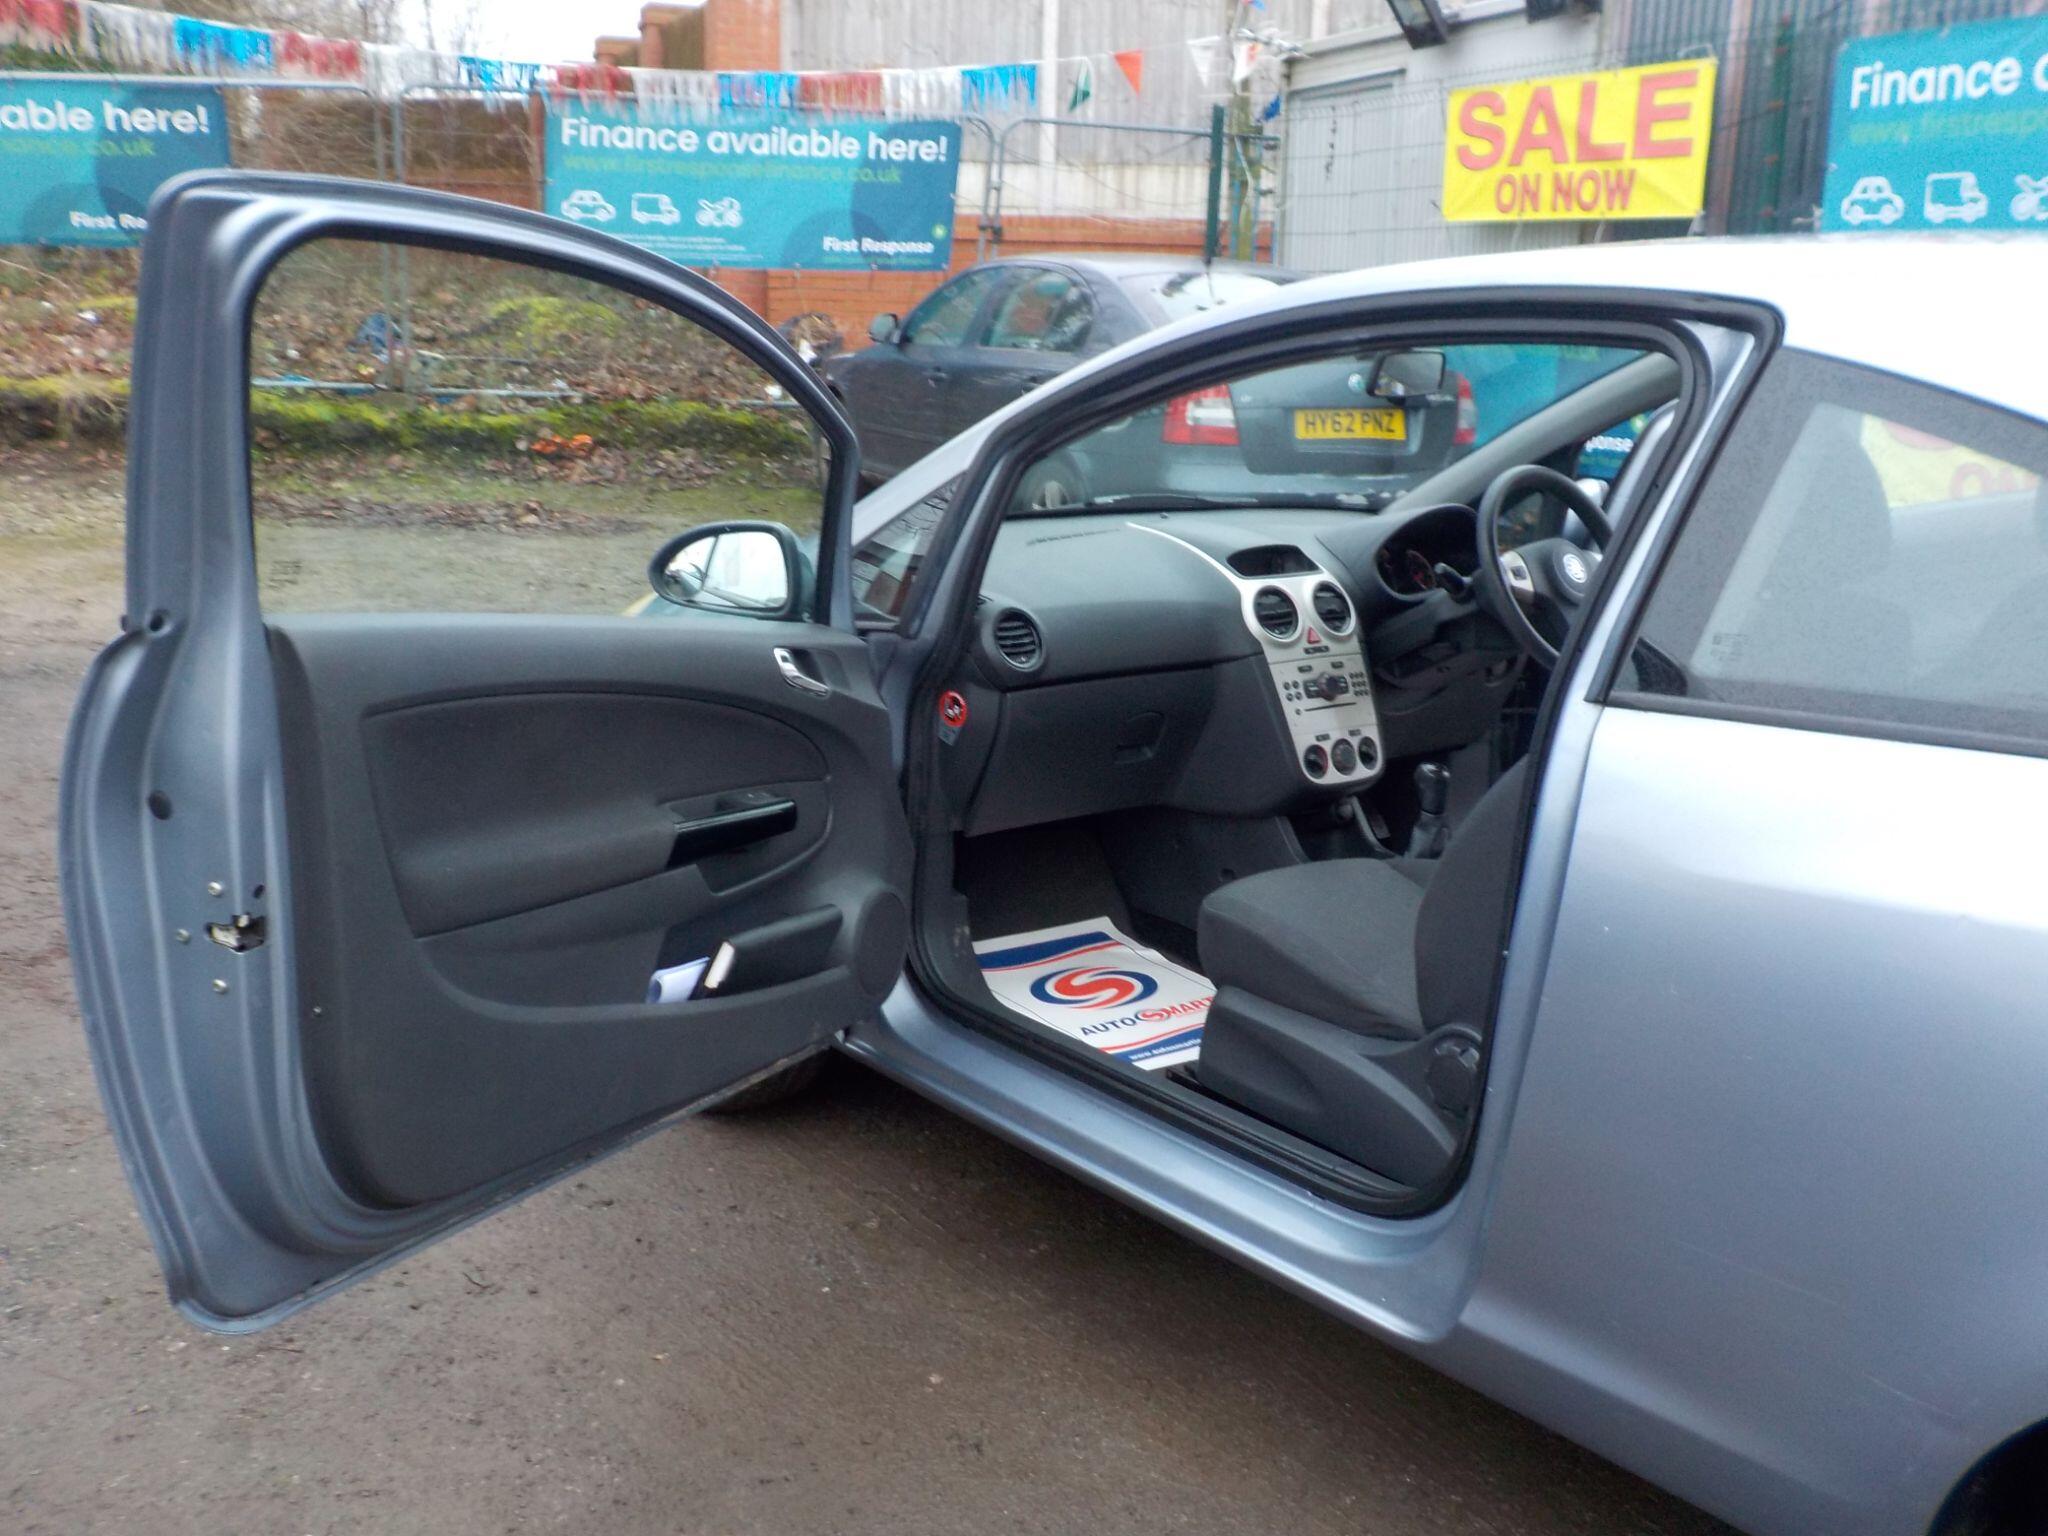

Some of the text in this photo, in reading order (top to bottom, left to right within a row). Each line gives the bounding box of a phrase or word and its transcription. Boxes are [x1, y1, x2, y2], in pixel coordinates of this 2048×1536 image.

[1850, 57, 2022, 109] Finance
[0, 98, 210, 134] able here!
[1459, 72, 1696, 170] SALE
[561, 117, 948, 162] Finance available here!
[1496, 171, 1638, 213] ON NOW
[823, 237, 934, 255] First Response
[1304, 411, 1395, 433] HY62 PNZ
